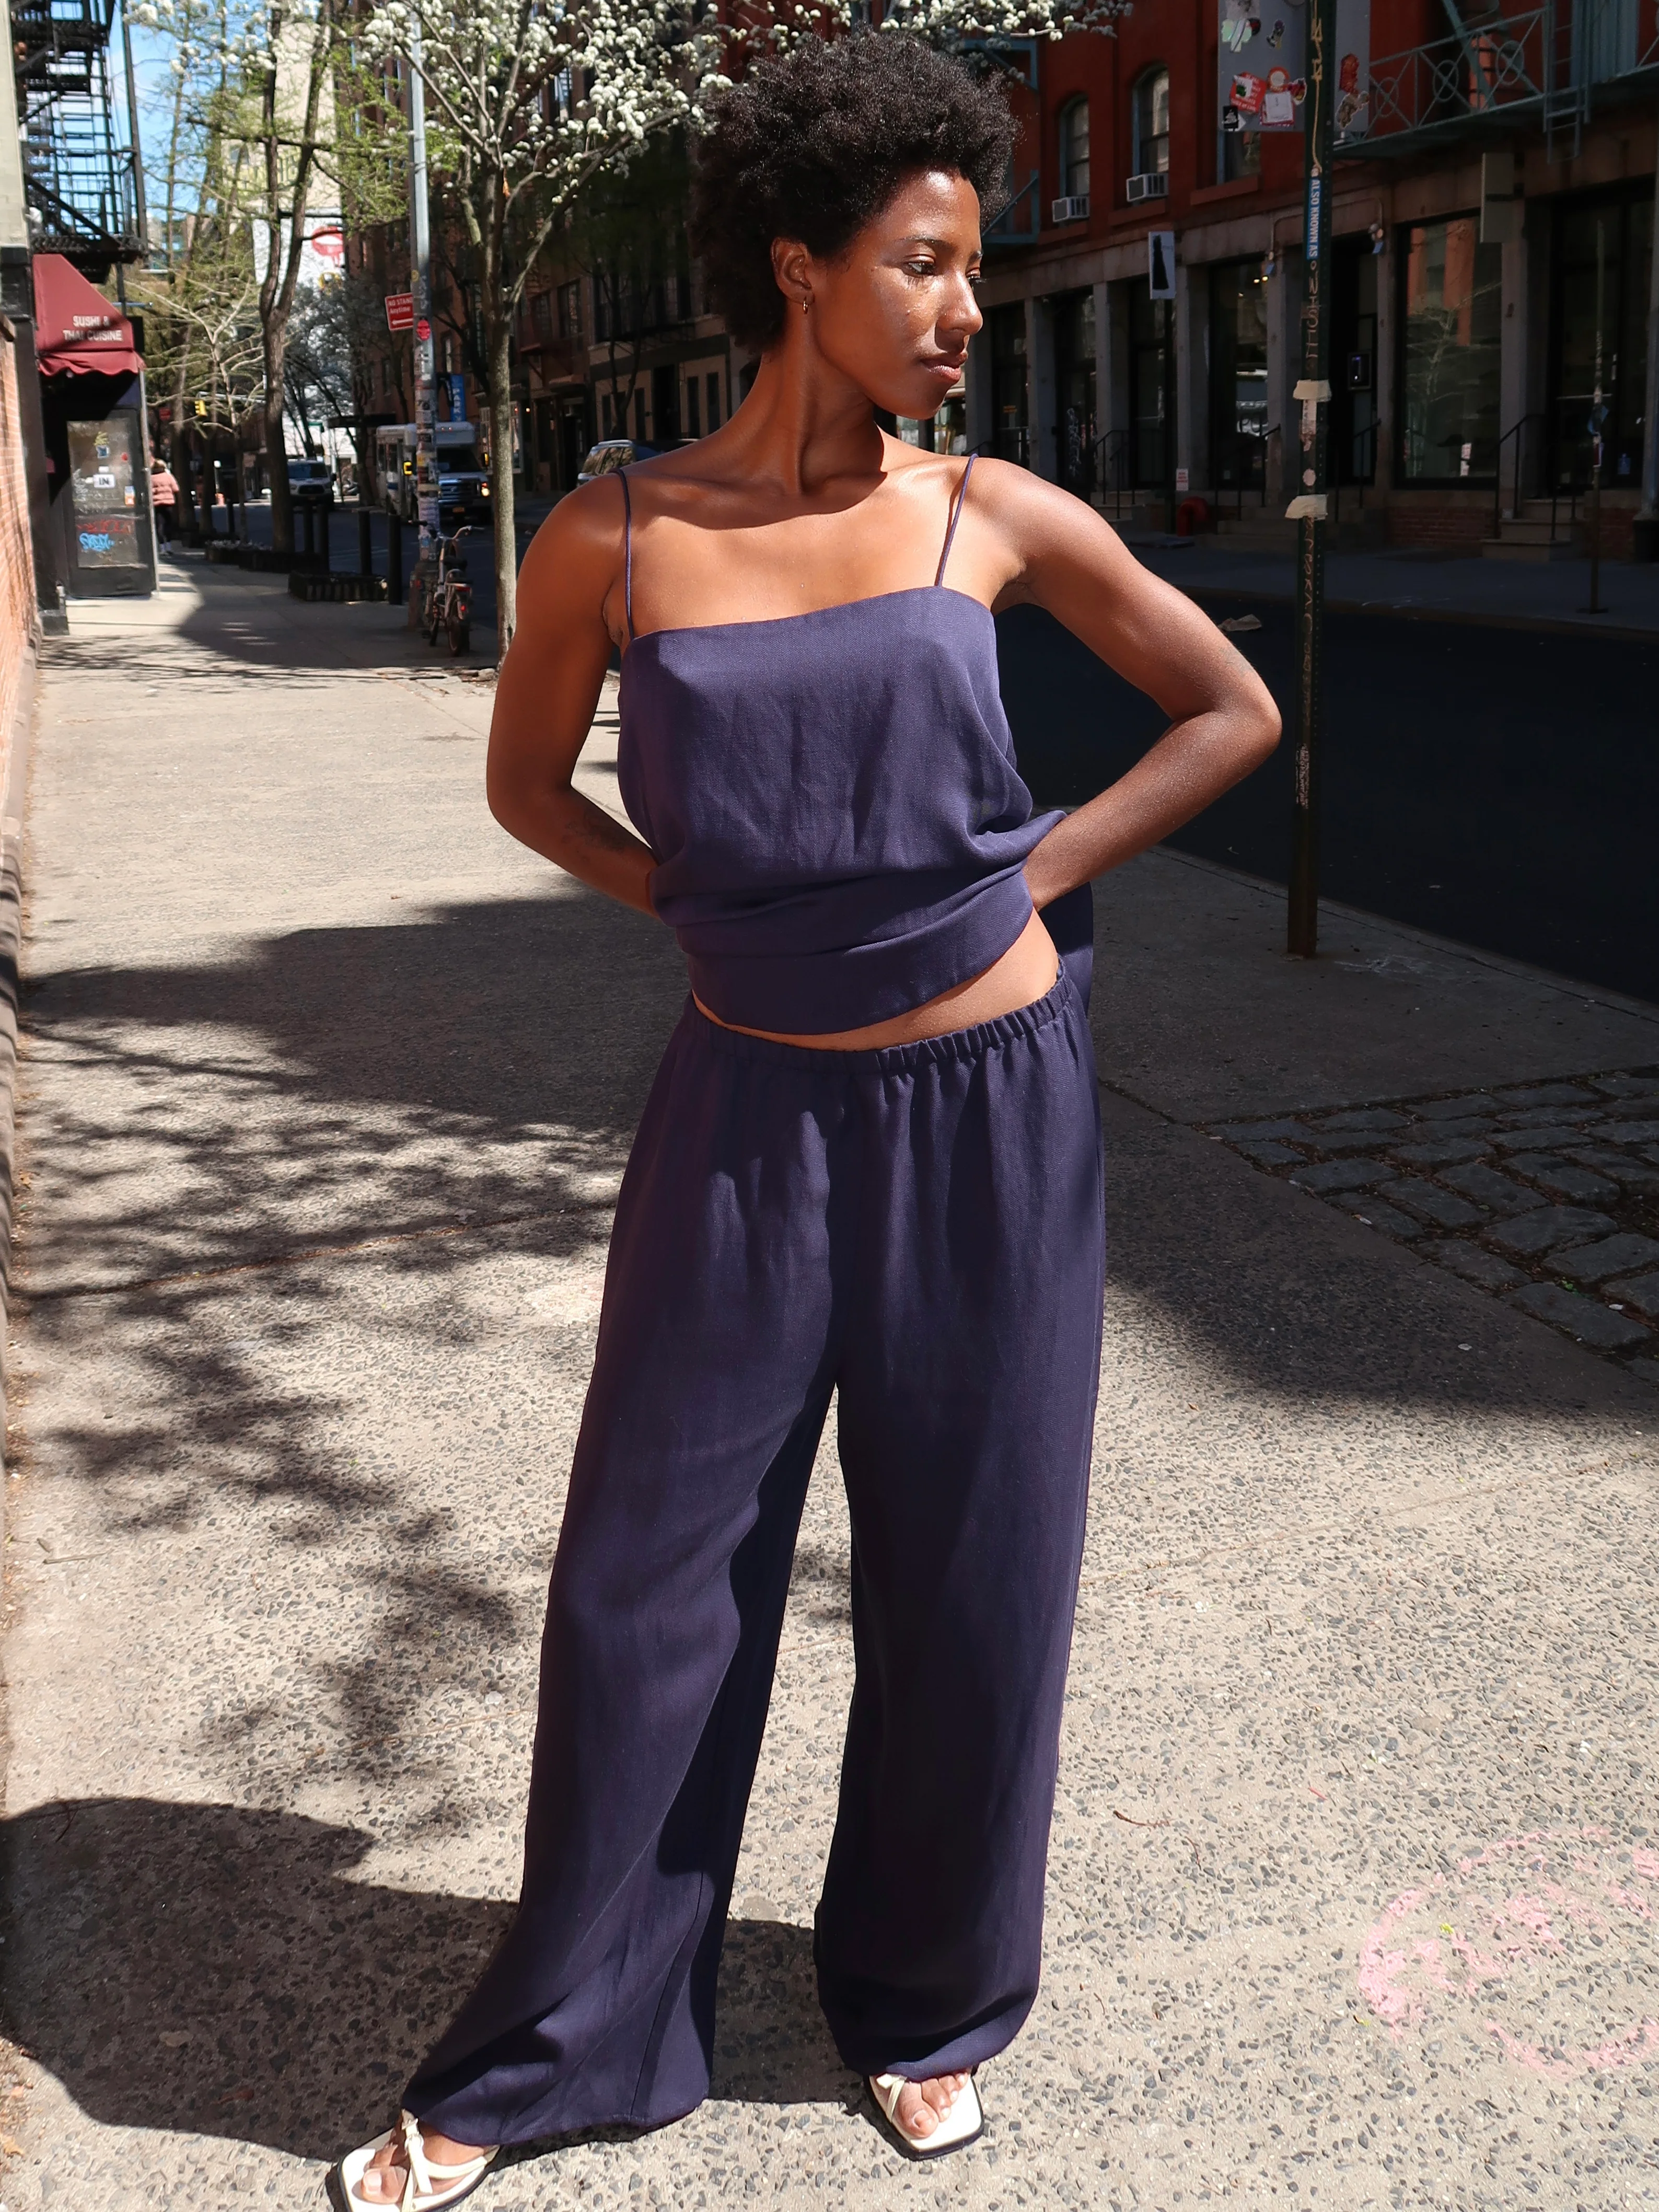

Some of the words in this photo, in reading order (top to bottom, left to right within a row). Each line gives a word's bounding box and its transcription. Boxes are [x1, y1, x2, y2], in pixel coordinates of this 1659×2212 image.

[1310, 179, 1320, 205] ALSO
[1309, 206, 1319, 243] KNOWN
[1308, 244, 1318, 257] AS
[73, 315, 100, 327] SUSHI
[62, 329, 85, 341] THAI
[87, 330, 123, 341] CUISINE
[99, 477, 110, 485] IN
